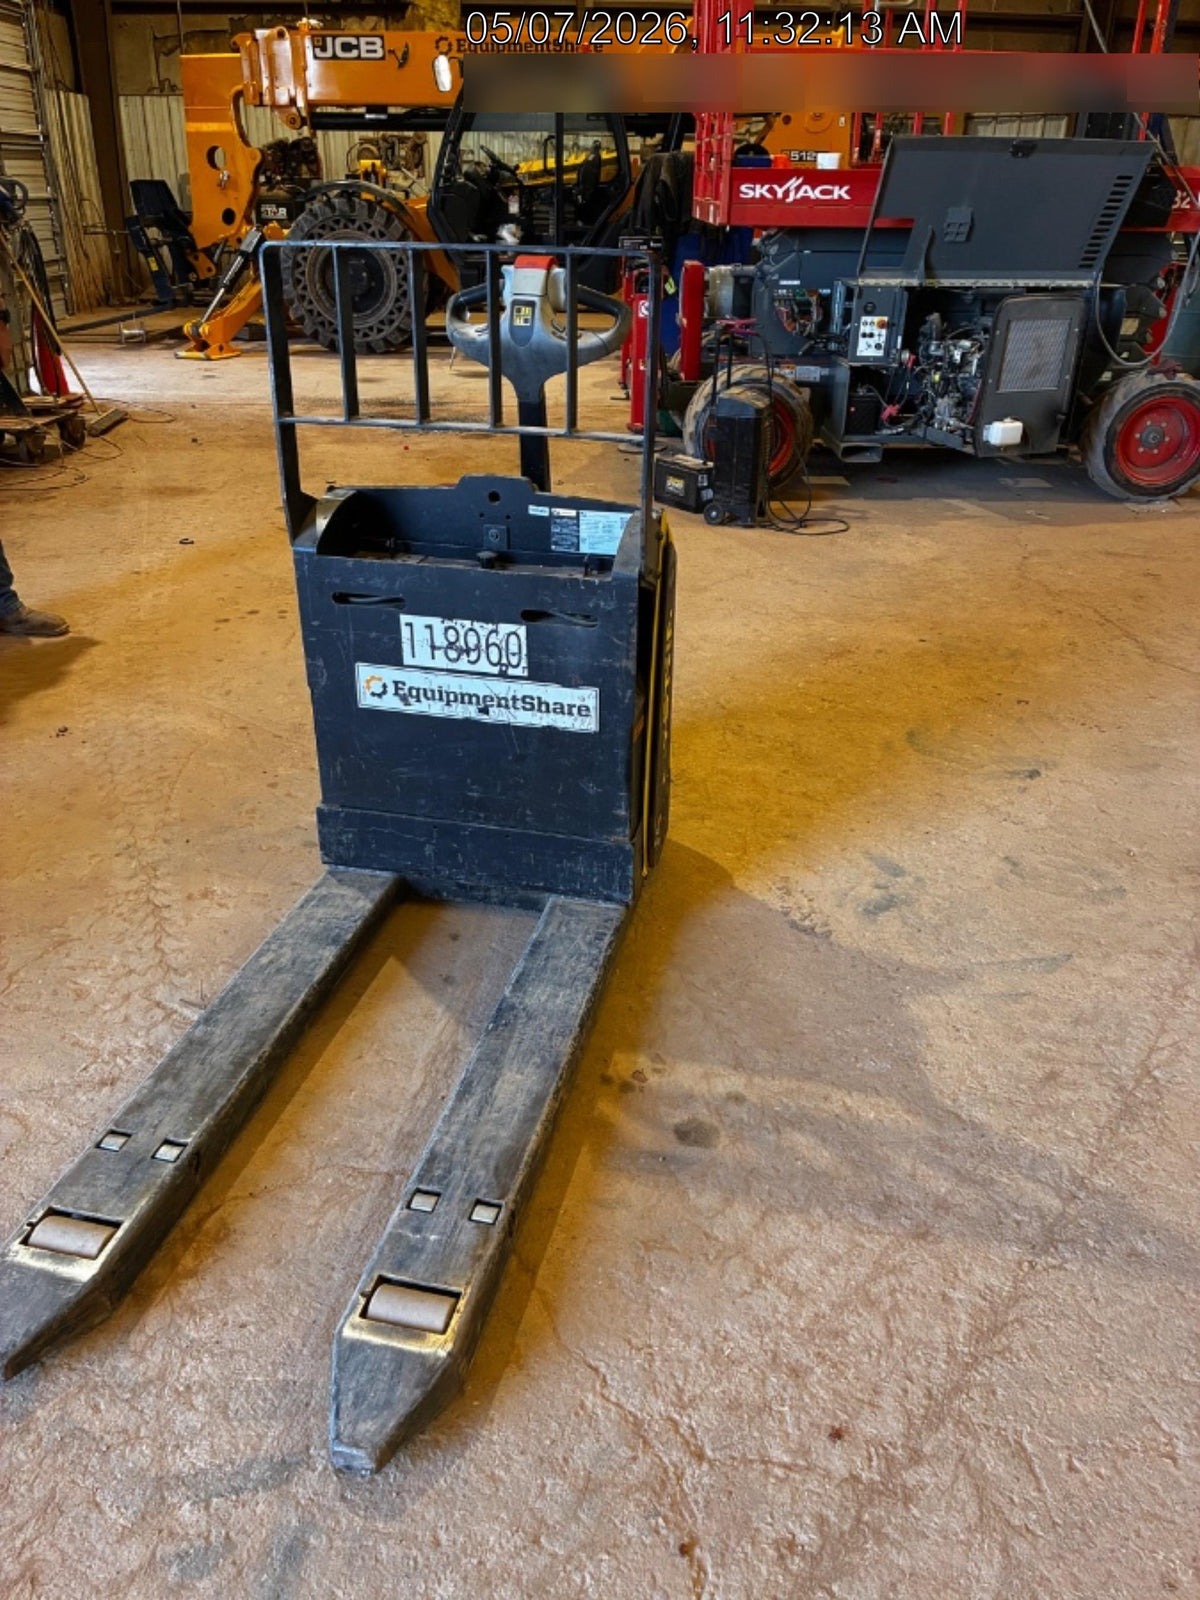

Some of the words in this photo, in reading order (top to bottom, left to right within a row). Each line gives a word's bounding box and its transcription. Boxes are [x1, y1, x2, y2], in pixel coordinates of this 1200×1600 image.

[313, 36, 385, 59] JCB
[738, 175, 852, 203] SKYJACK
[404, 621, 522, 669] 118960
[391, 680, 592, 718] EquipmentShare
